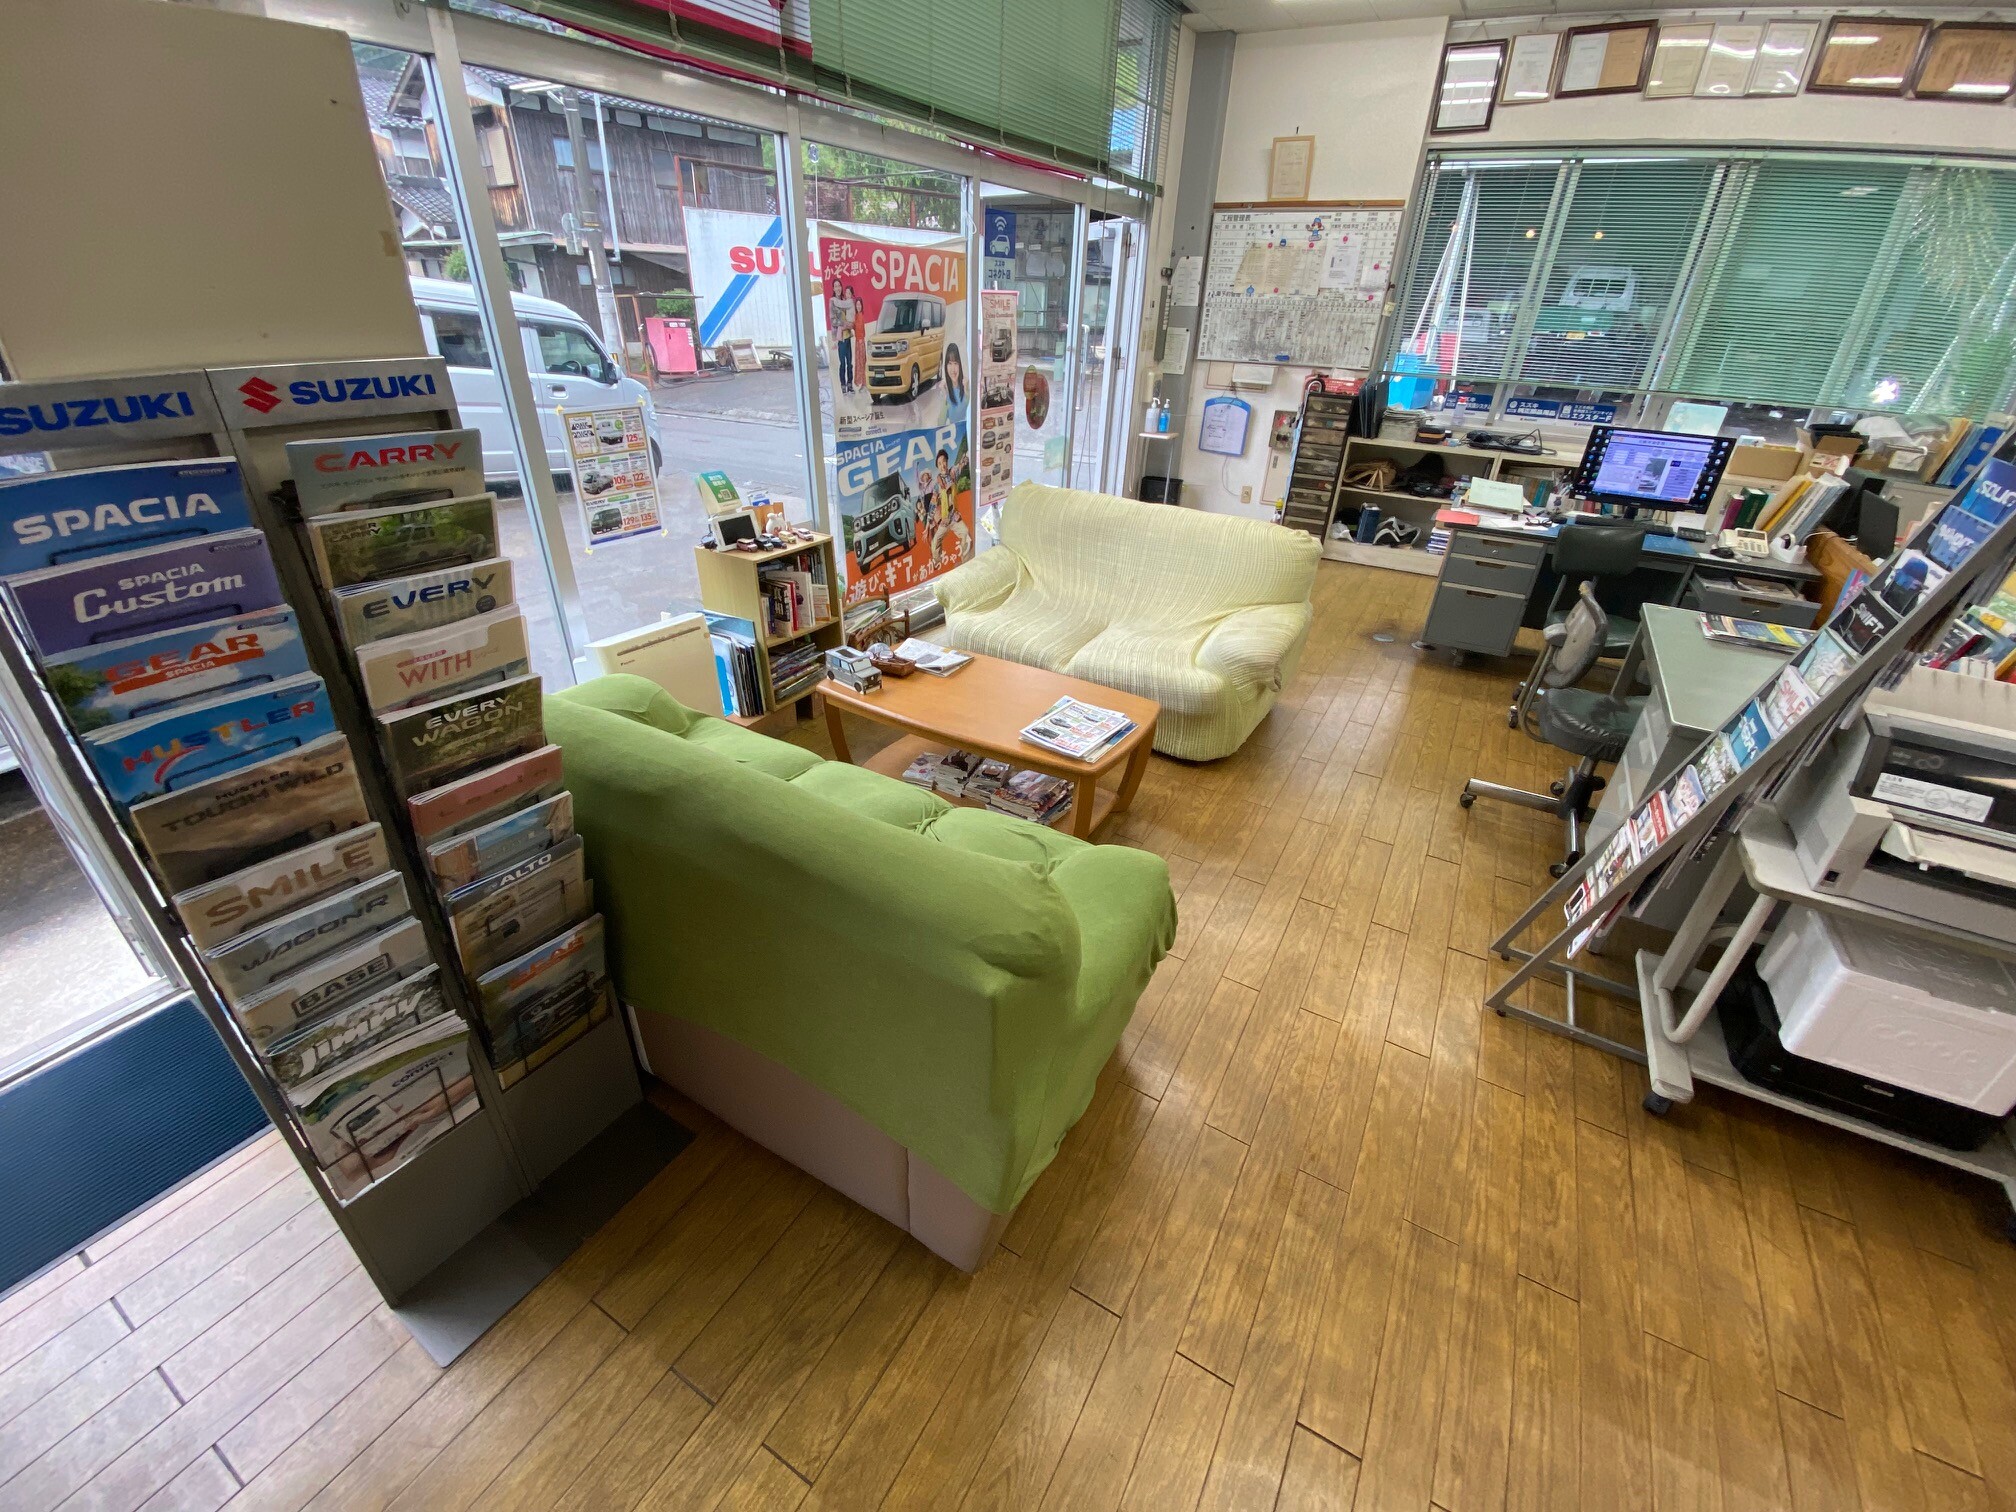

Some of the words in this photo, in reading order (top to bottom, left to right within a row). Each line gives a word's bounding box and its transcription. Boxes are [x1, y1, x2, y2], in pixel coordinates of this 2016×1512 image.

[871, 249, 959, 292] SPACIA
[989, 299, 1011, 311] SMILE
[288, 374, 437, 405] SUZUKI
[0, 391, 195, 436] SUZUKI
[314, 442, 464, 473] CARRY
[625, 433, 639, 443] 125
[837, 440, 885, 466] SPACIA
[838, 423, 957, 497] GEAR
[13, 493, 221, 545] SPACIA
[118, 563, 205, 591] SPACIA
[849, 540, 964, 602] 遊びのギアがあがっちゃう
[73, 574, 246, 624] Custom
[362, 573, 496, 619] EVERY
[1855, 602, 1885, 634] SWIFT
[104, 633, 260, 682] GEAR
[165, 660, 216, 679] SPACIA
[398, 649, 473, 688] WITH
[411, 701, 523, 747] WAGON
[424, 694, 511, 730] EVERY
[122, 701, 316, 773] HUSTLER
[215, 770, 290, 801] HUSTLER
[275, 761, 345, 793] WILD
[205, 842, 375, 928] SMILE
[500, 853, 552, 887] ALTO
[299, 959, 387, 1012] BASE
